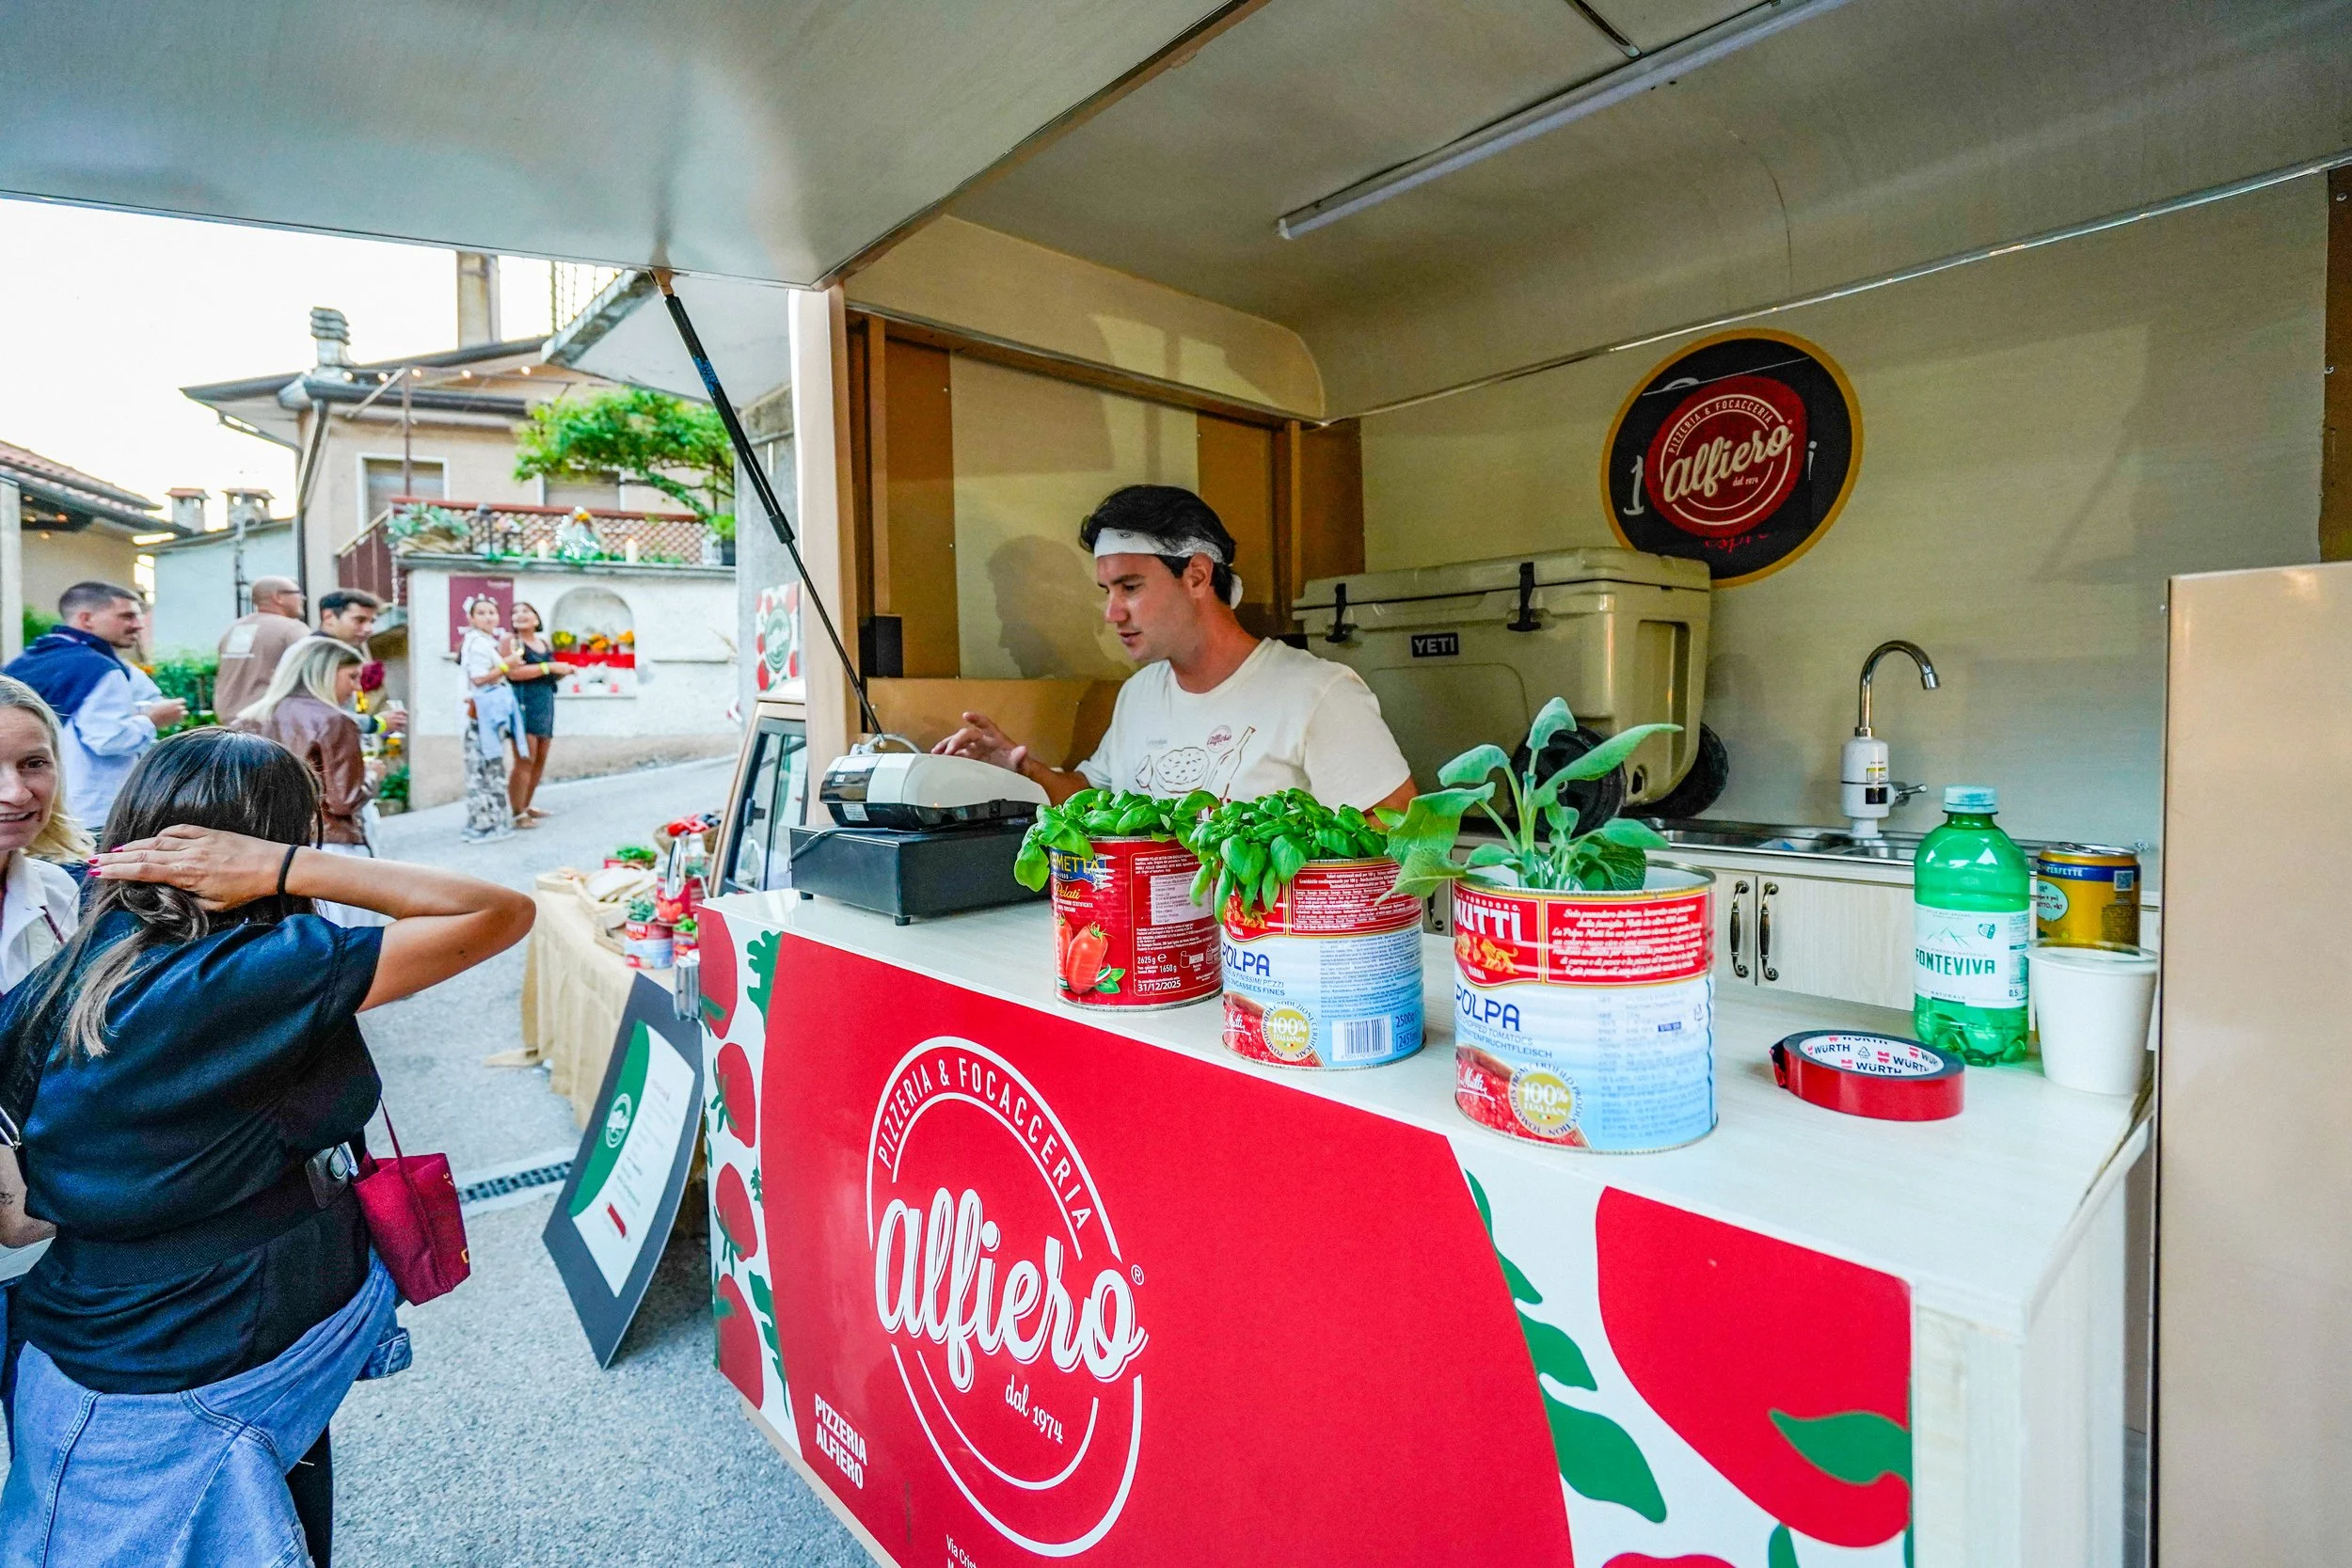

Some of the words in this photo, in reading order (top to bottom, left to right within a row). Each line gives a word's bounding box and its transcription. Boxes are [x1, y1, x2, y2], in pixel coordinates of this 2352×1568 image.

[1668, 413, 1701, 453] PIZZERIA
[1715, 399, 1774, 424] FOCACCERIA
[1413, 637, 1455, 654] YETI
[1055, 881, 1081, 900] Pelati
[1136, 956, 1152, 965] 2625
[1159, 965, 1172, 974] 1650
[1137, 979, 1182, 991] 31/12/2025
[1263, 987, 1285, 996] FINES
[1272, 1017, 1307, 1035] 100%
[1814, 1043, 1851, 1054] WÜRTH
[1521, 1081, 1568, 1107] 100%
[878, 1064, 933, 1169] PIZZERIA
[938, 1058, 950, 1086] &
[959, 1057, 1092, 1230] FOCACCERIA
[875, 1187, 1149, 1394] alfiero
[1005, 1373, 1029, 1418] dal
[1032, 1405, 1064, 1445] 1974
[814, 1392, 867, 1466] PIZZERIA
[816, 1422, 864, 1490] ALFIERO
[946, 1533, 959, 1559] Via
